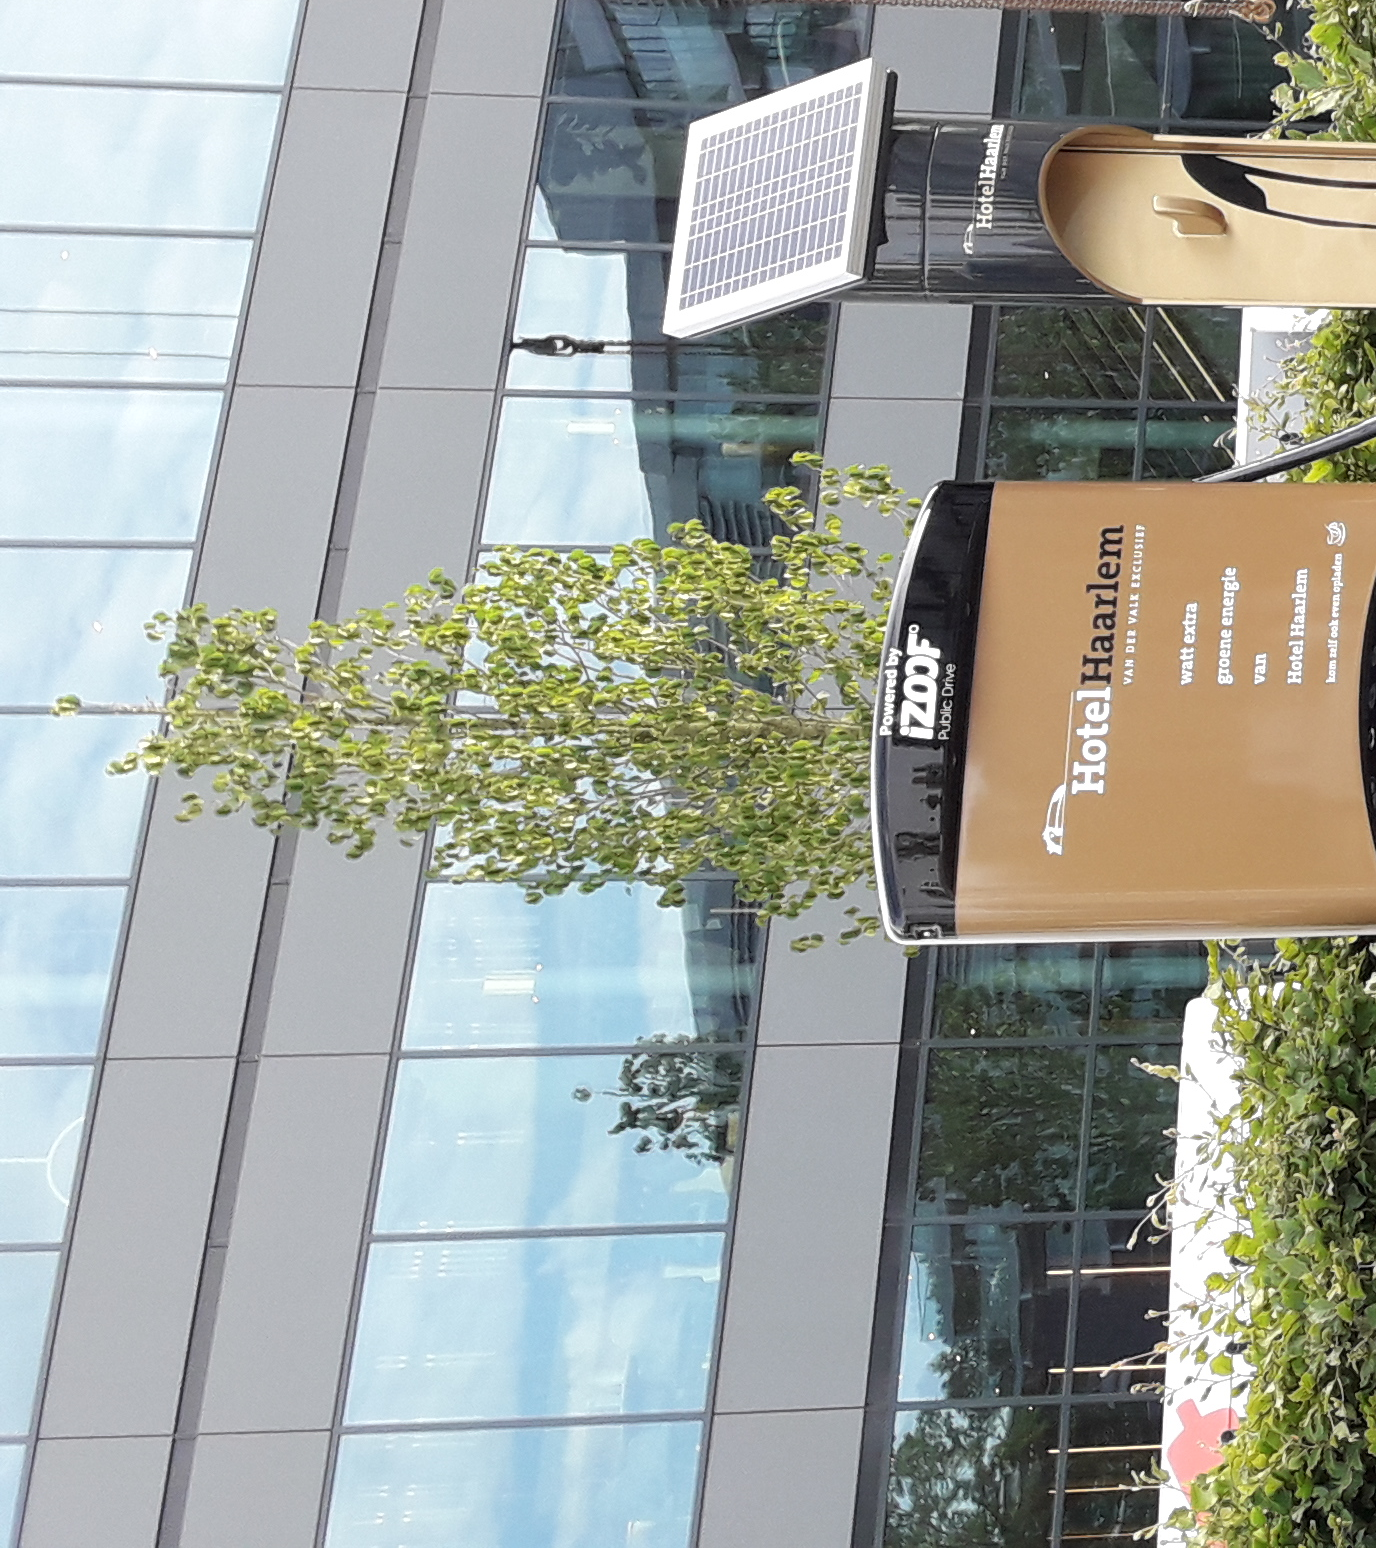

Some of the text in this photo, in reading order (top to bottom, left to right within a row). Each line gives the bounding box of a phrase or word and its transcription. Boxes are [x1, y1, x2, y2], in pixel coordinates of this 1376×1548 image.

[1122, 524, 1146, 685] VAN DER VALK EXCLUSIEF
[1179, 602, 1198, 686] watt extra
[1217, 567, 1240, 685] groene energie
[1287, 568, 1308, 685] Hotel Haarlem
[1325, 553, 1344, 684] kom zelf ook even opladen
[879, 648, 902, 736] Powered by
[938, 663, 956, 740] Public Drive
[1253, 653, 1267, 685] van
